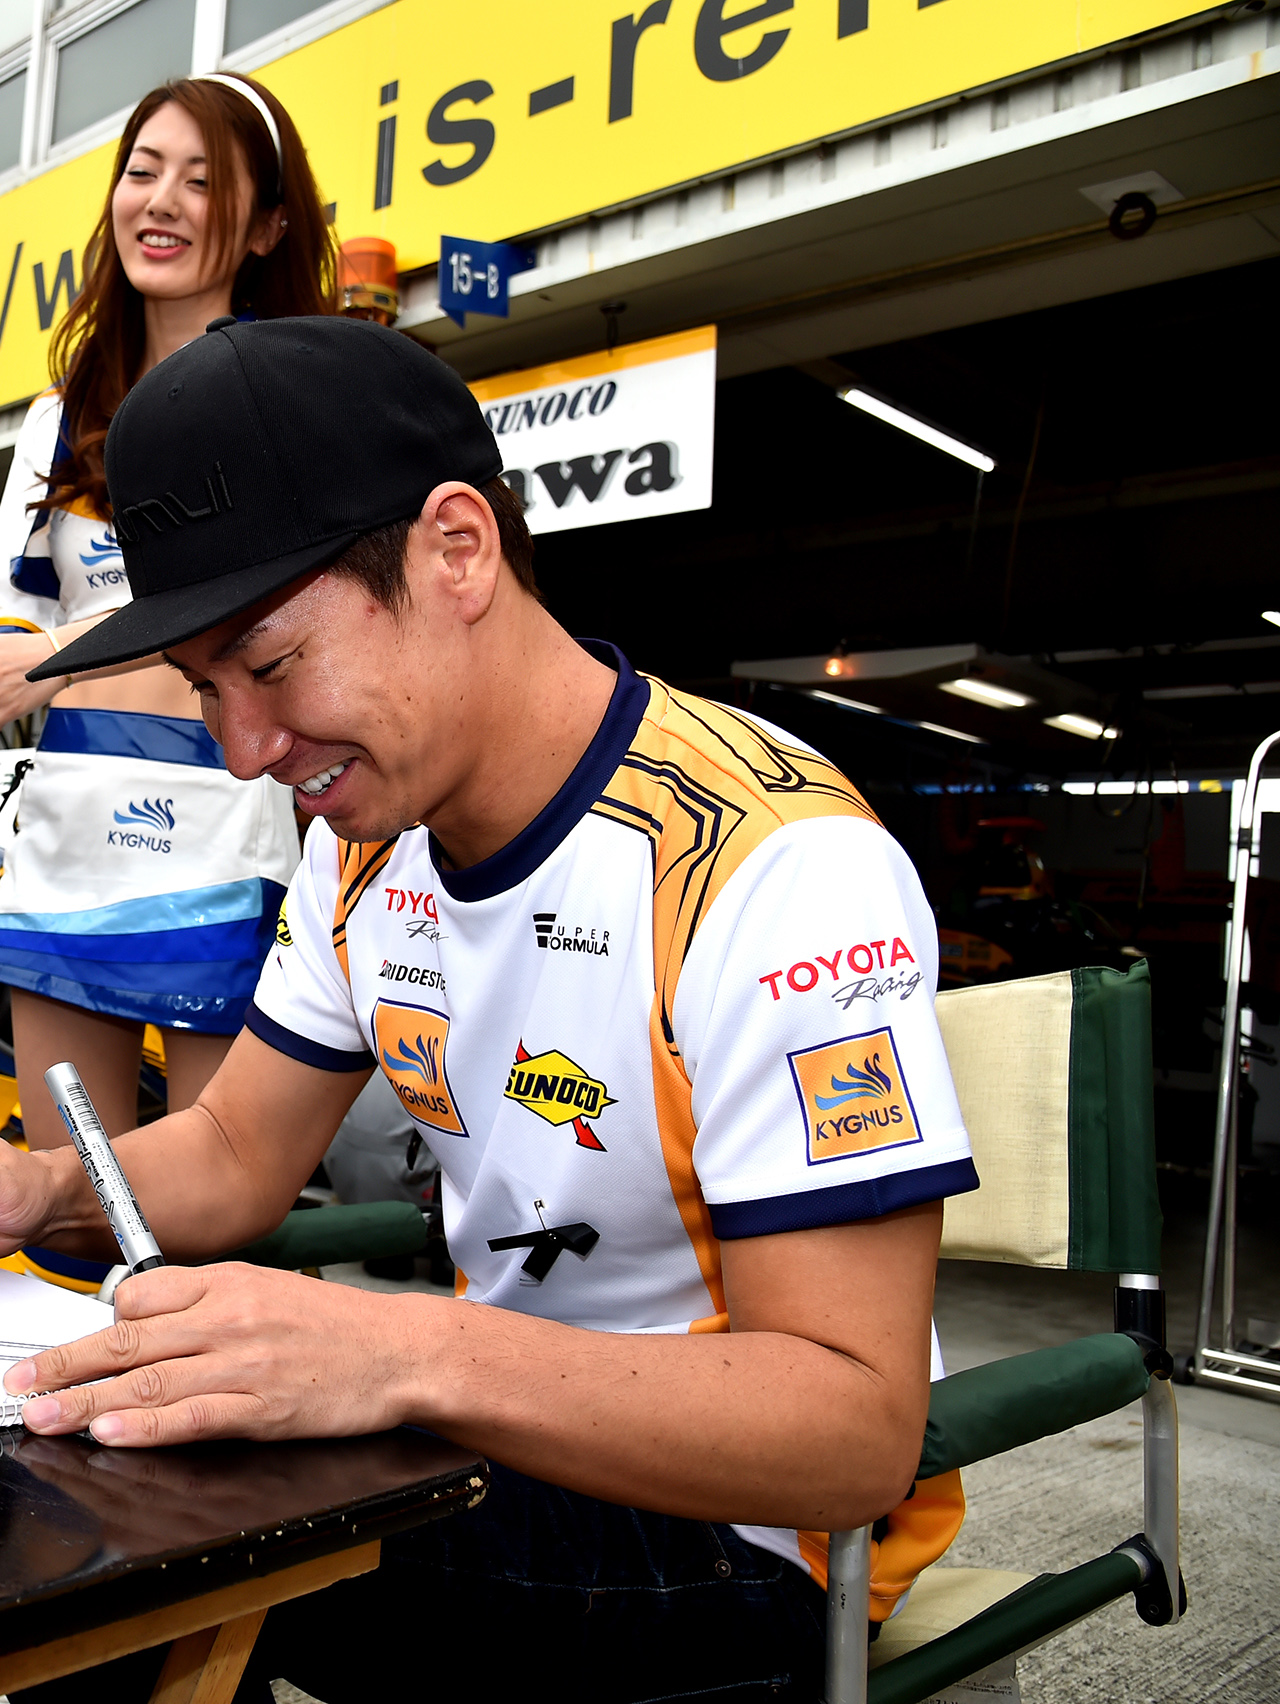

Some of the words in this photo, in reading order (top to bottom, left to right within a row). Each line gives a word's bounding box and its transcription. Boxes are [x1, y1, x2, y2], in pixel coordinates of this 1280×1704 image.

[448, 251, 500, 299] 15-B
[107, 830, 172, 854] KYGNUS
[758, 937, 915, 1001] TOYOTA
[831, 971, 924, 1011] Racing
[815, 1104, 904, 1142] KYGNUS
